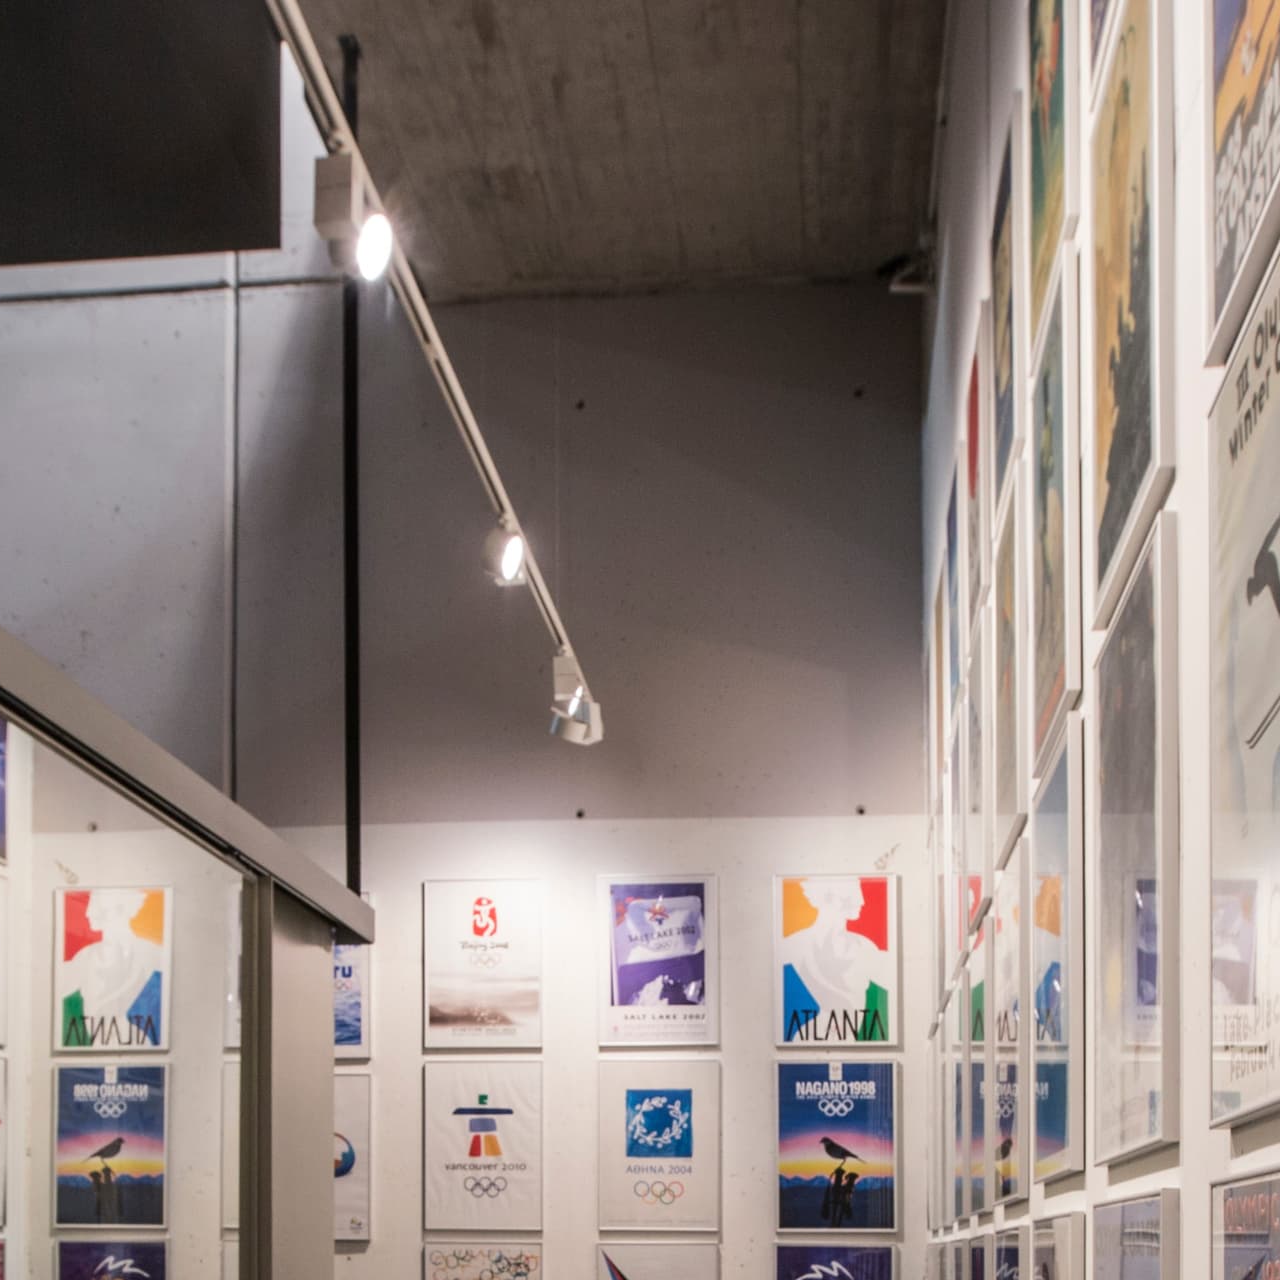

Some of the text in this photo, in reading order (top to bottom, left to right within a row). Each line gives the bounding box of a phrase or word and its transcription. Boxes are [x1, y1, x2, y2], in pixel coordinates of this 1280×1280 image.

[786, 1008, 887, 1041] ATLANTA
[796, 1080, 877, 1096] NAGANO 1998
[445, 1162, 527, 1171] vancouver 2010
[668, 1164, 693, 1175] 2004
